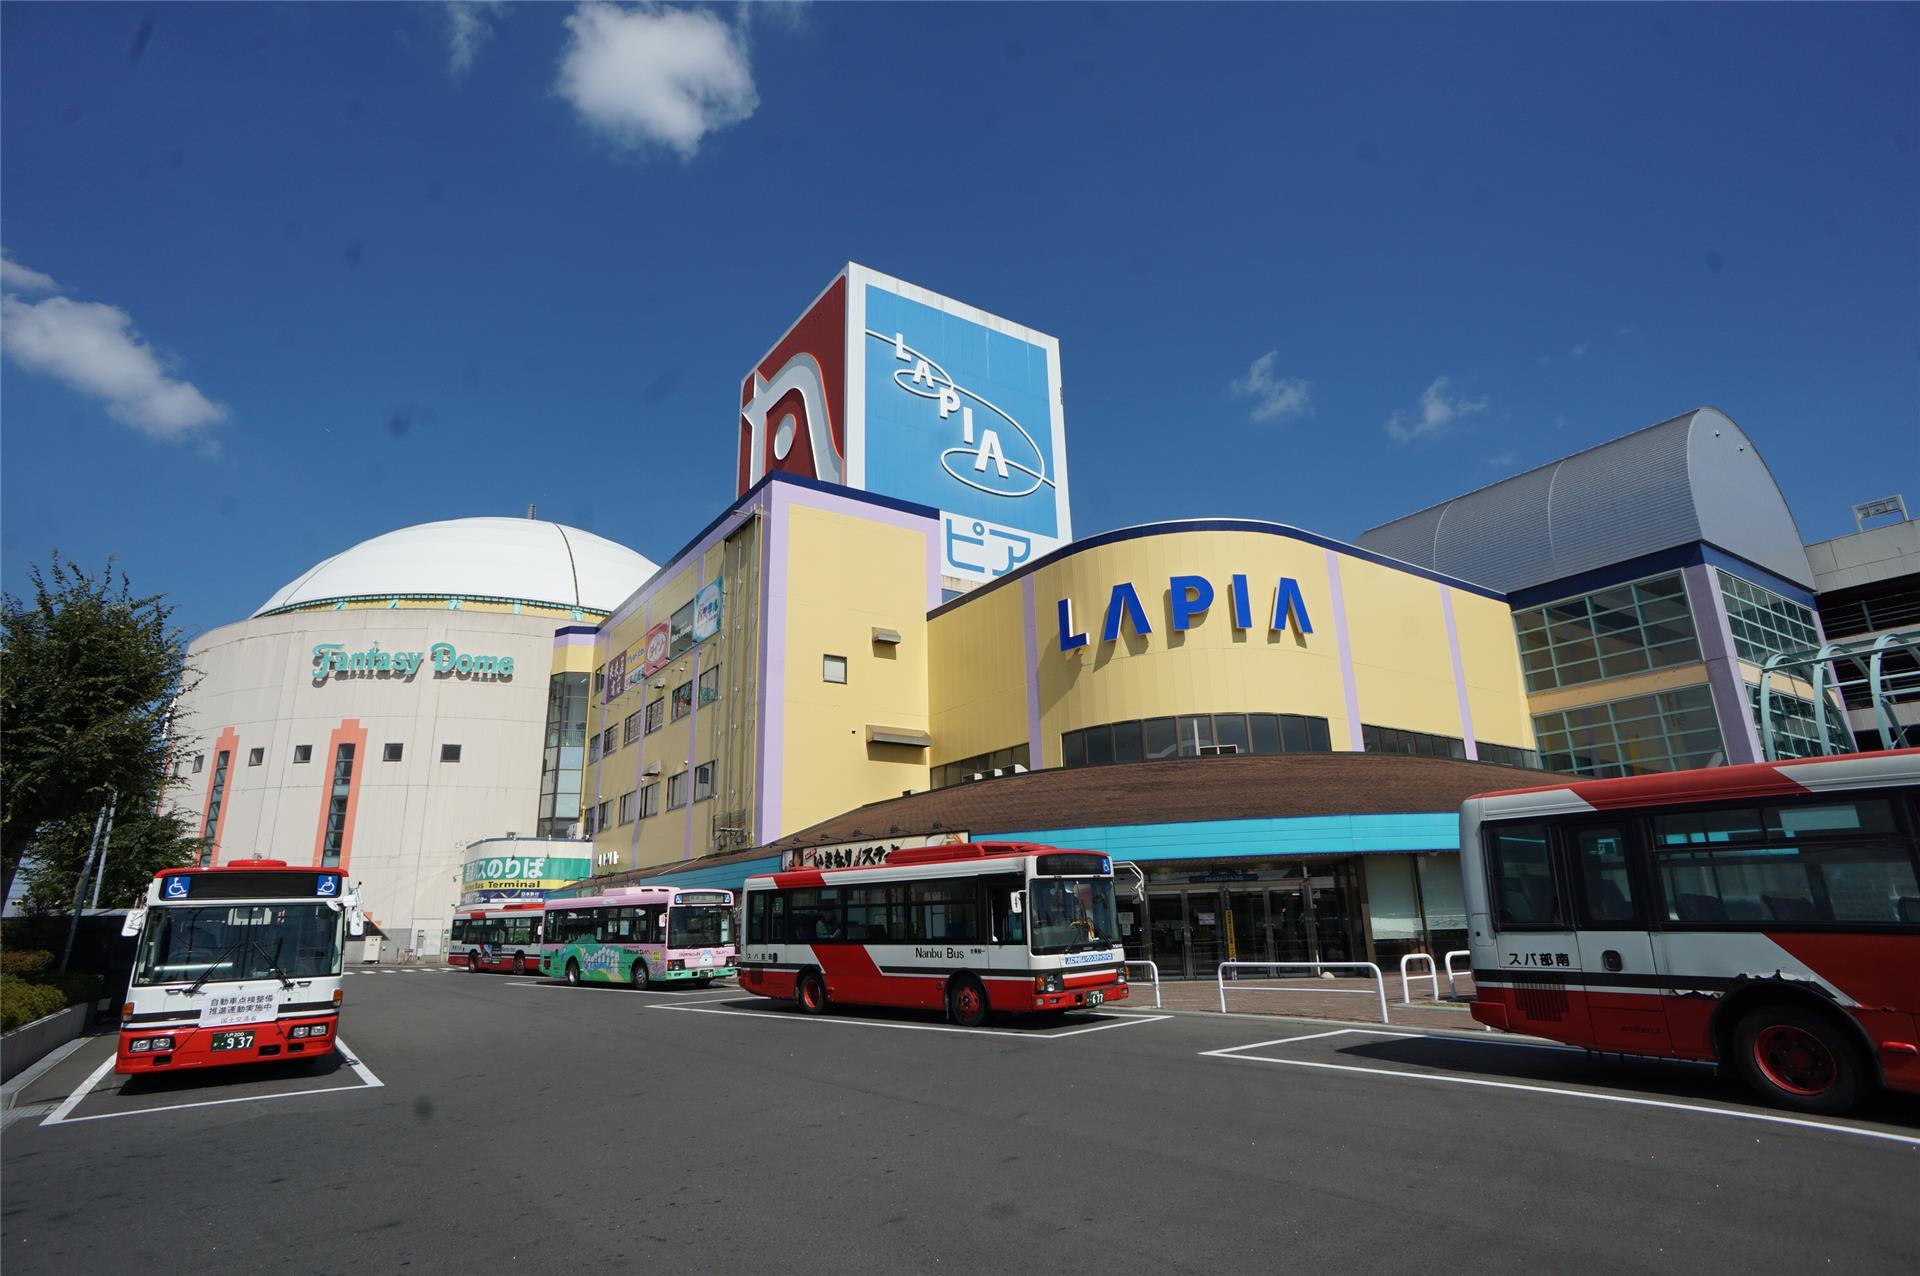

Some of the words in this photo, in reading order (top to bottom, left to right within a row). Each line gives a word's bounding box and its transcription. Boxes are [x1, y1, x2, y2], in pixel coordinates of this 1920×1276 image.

[895, 332, 1009, 478] LAPIA
[1057, 573, 1314, 652] LAPIA
[311, 641, 424, 682] Fantasy
[430, 642, 515, 678] Dome
[915, 947, 943, 958] Nanbu
[946, 947, 965, 959] Bus
[208, 1003, 272, 1015] 推進運動実施中
[210, 994, 273, 1007] 自動車点検整備
